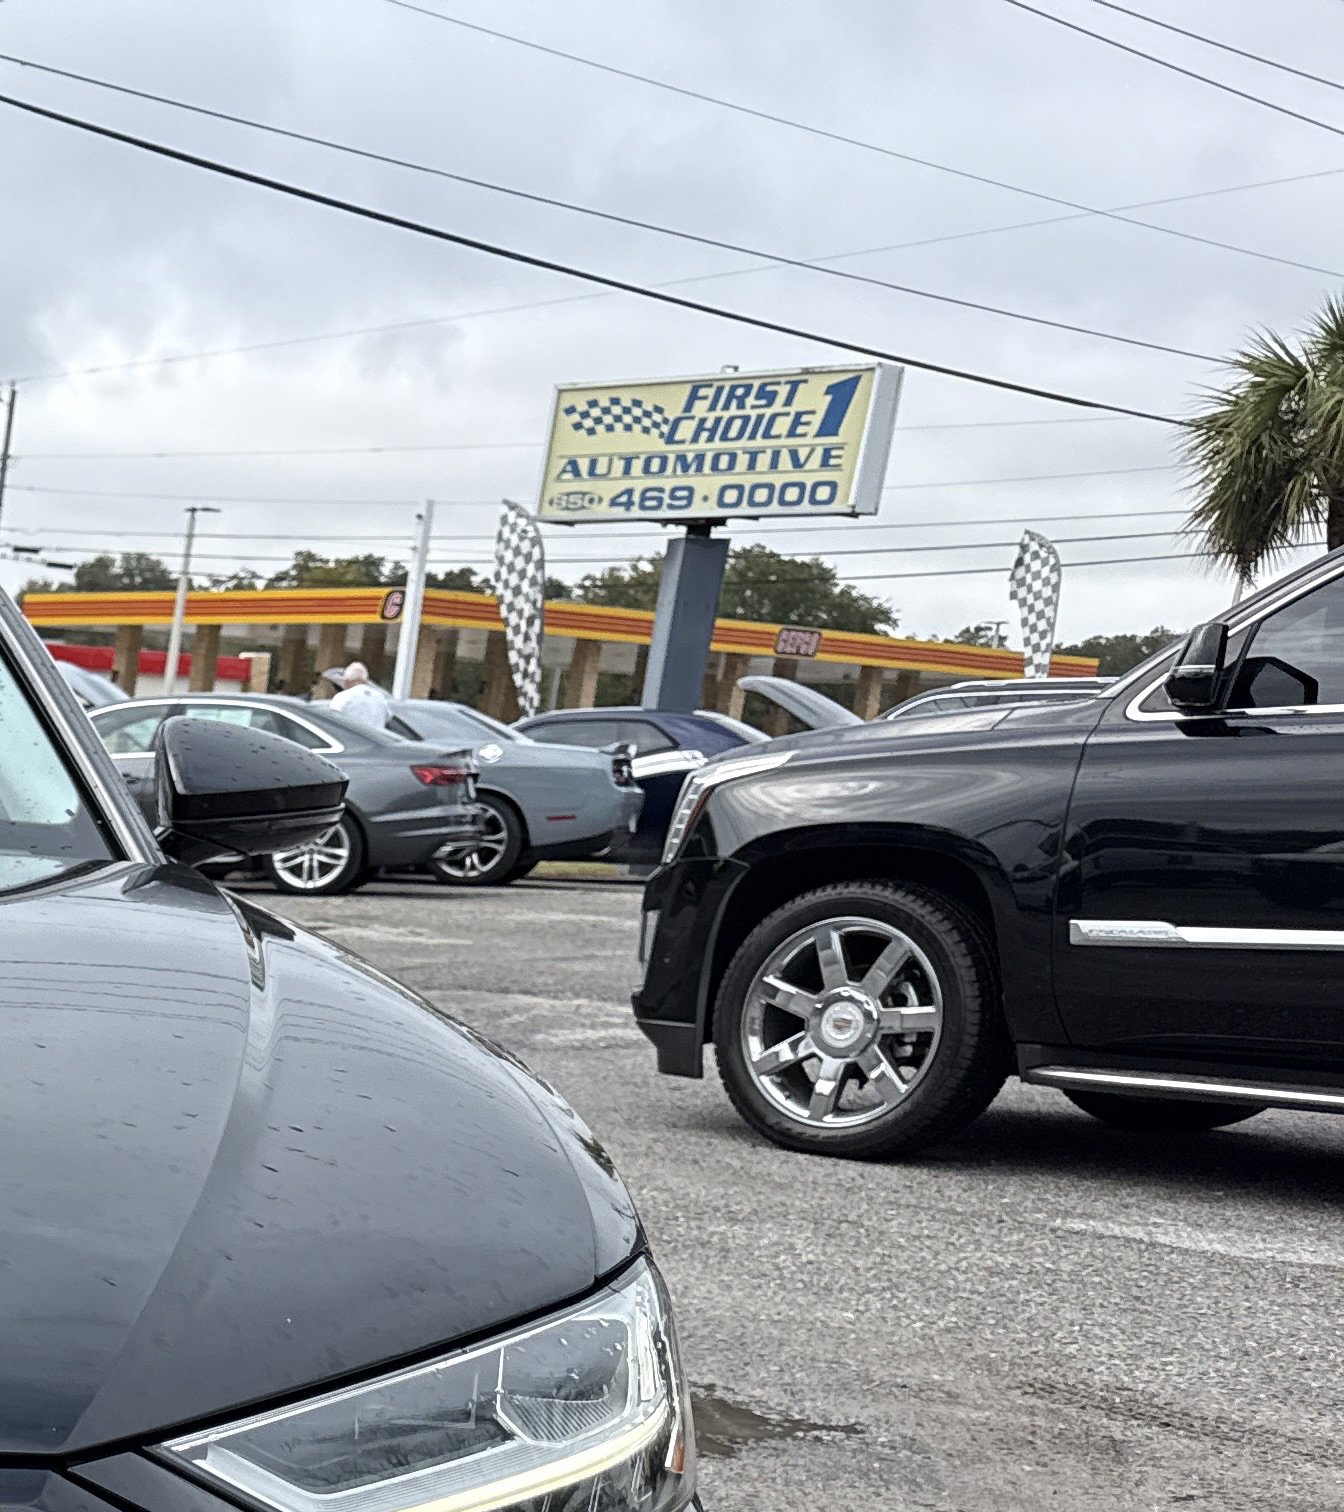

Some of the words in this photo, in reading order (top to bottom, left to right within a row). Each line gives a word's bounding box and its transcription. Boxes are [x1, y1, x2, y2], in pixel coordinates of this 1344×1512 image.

[664, 410, 817, 445] CHOICE
[813, 374, 863, 438] 1
[681, 379, 809, 414] FIRST
[555, 445, 846, 482] AUTOMOTIVE
